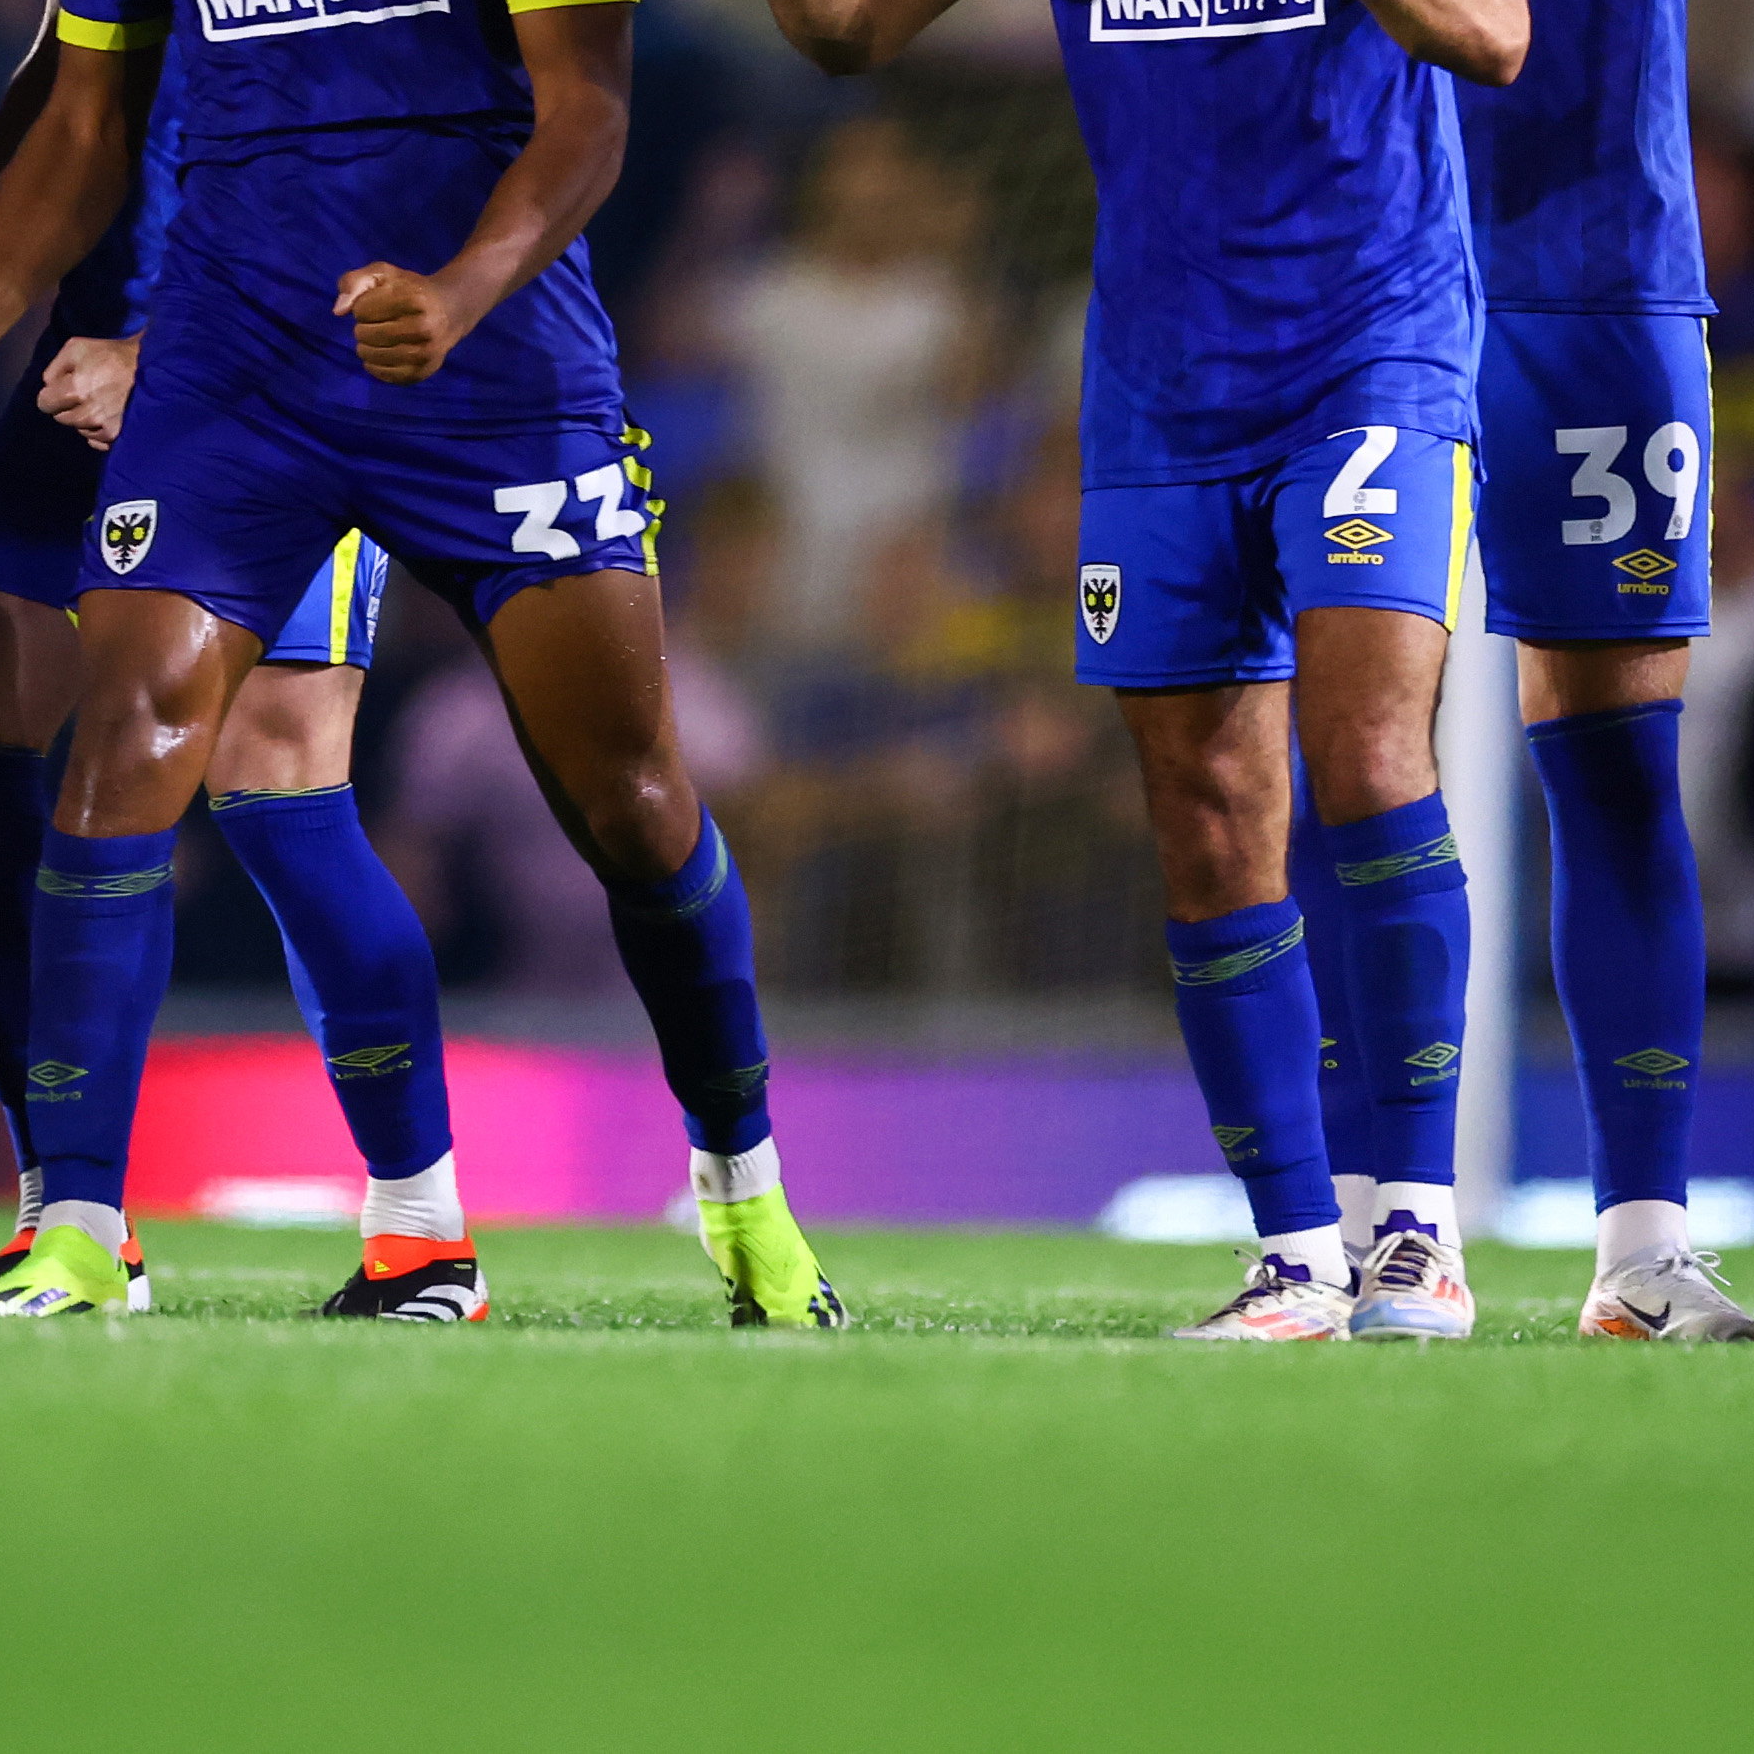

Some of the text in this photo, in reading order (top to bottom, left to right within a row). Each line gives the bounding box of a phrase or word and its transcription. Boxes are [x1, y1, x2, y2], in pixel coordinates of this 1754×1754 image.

[1323, 425, 1398, 519] 2
[1554, 420, 1701, 545] 39
[1327, 550, 1385, 566] umbro
[1617, 582, 1669, 595] umbro
